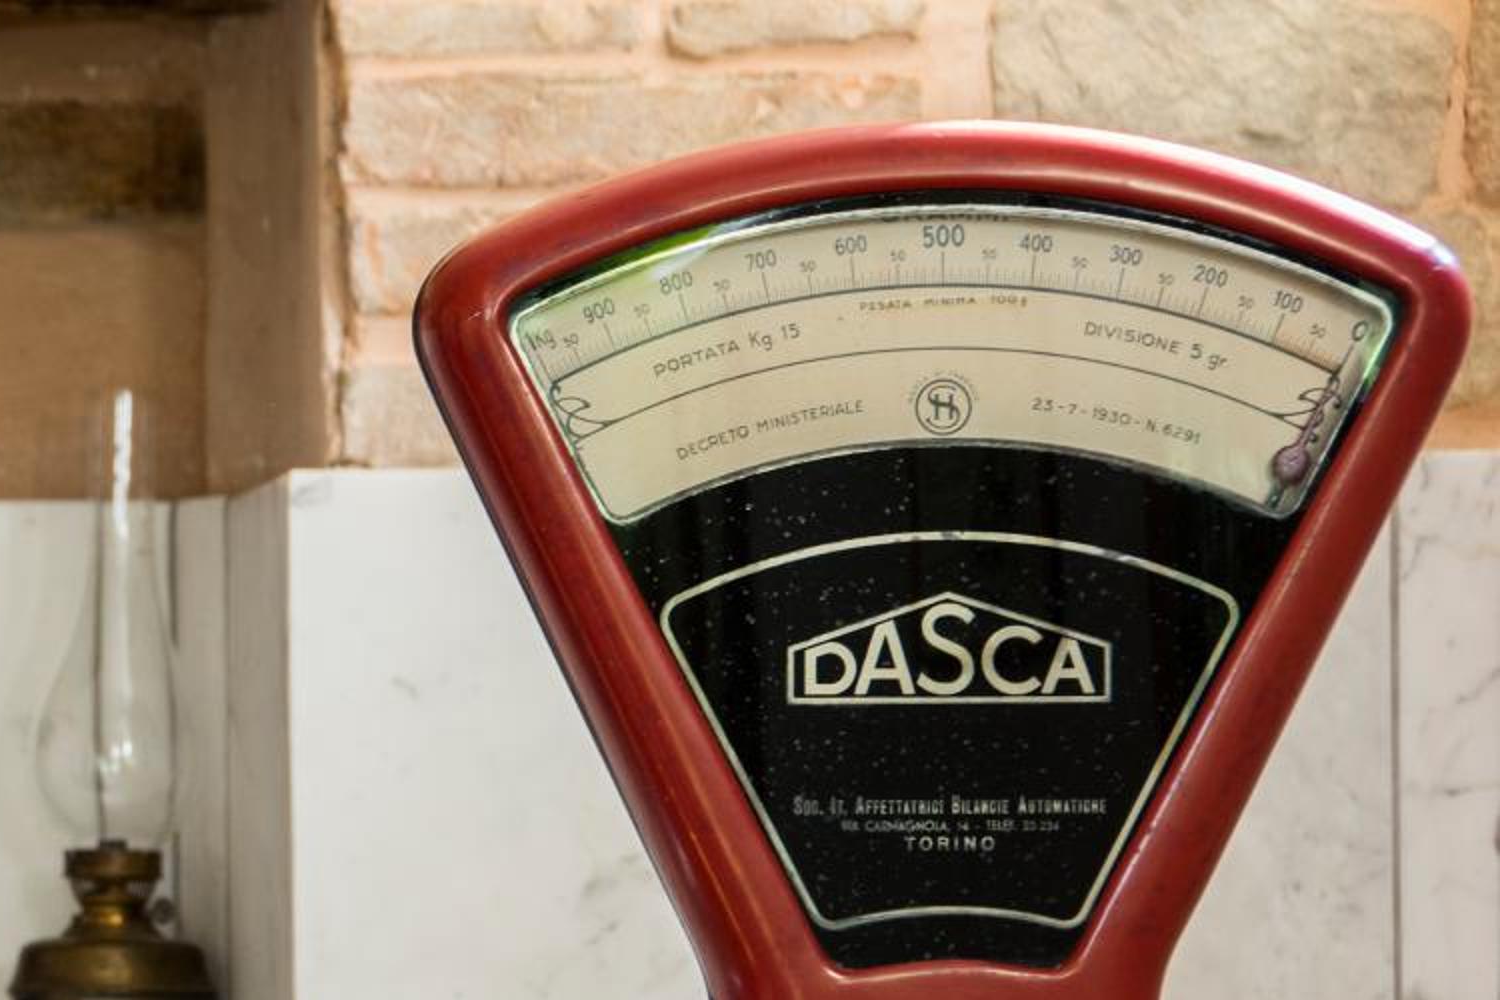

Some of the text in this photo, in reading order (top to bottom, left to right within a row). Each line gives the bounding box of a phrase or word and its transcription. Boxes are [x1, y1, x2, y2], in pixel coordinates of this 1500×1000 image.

[583, 298, 616, 324] 900
[658, 271, 694, 293] 800
[744, 250, 778, 271] 700
[800, 260, 817, 273] 50
[834, 234, 868, 256] 600
[890, 249, 906, 263] 50
[921, 224, 964, 248] 500
[1017, 234, 1053, 253] 400
[1108, 245, 1144, 267] 300
[1157, 272, 1175, 285] 50
[1193, 265, 1229, 288] 200
[1273, 289, 1304, 314] 100
[652, 322, 800, 378] PORTATA Kg 15
[1084, 320, 1228, 370] DIVISIONE 5 gr
[677, 400, 865, 462] DECRETO MINISTERIALE
[804, 602, 1096, 696] DASCA
[904, 836, 996, 851] TORINO
